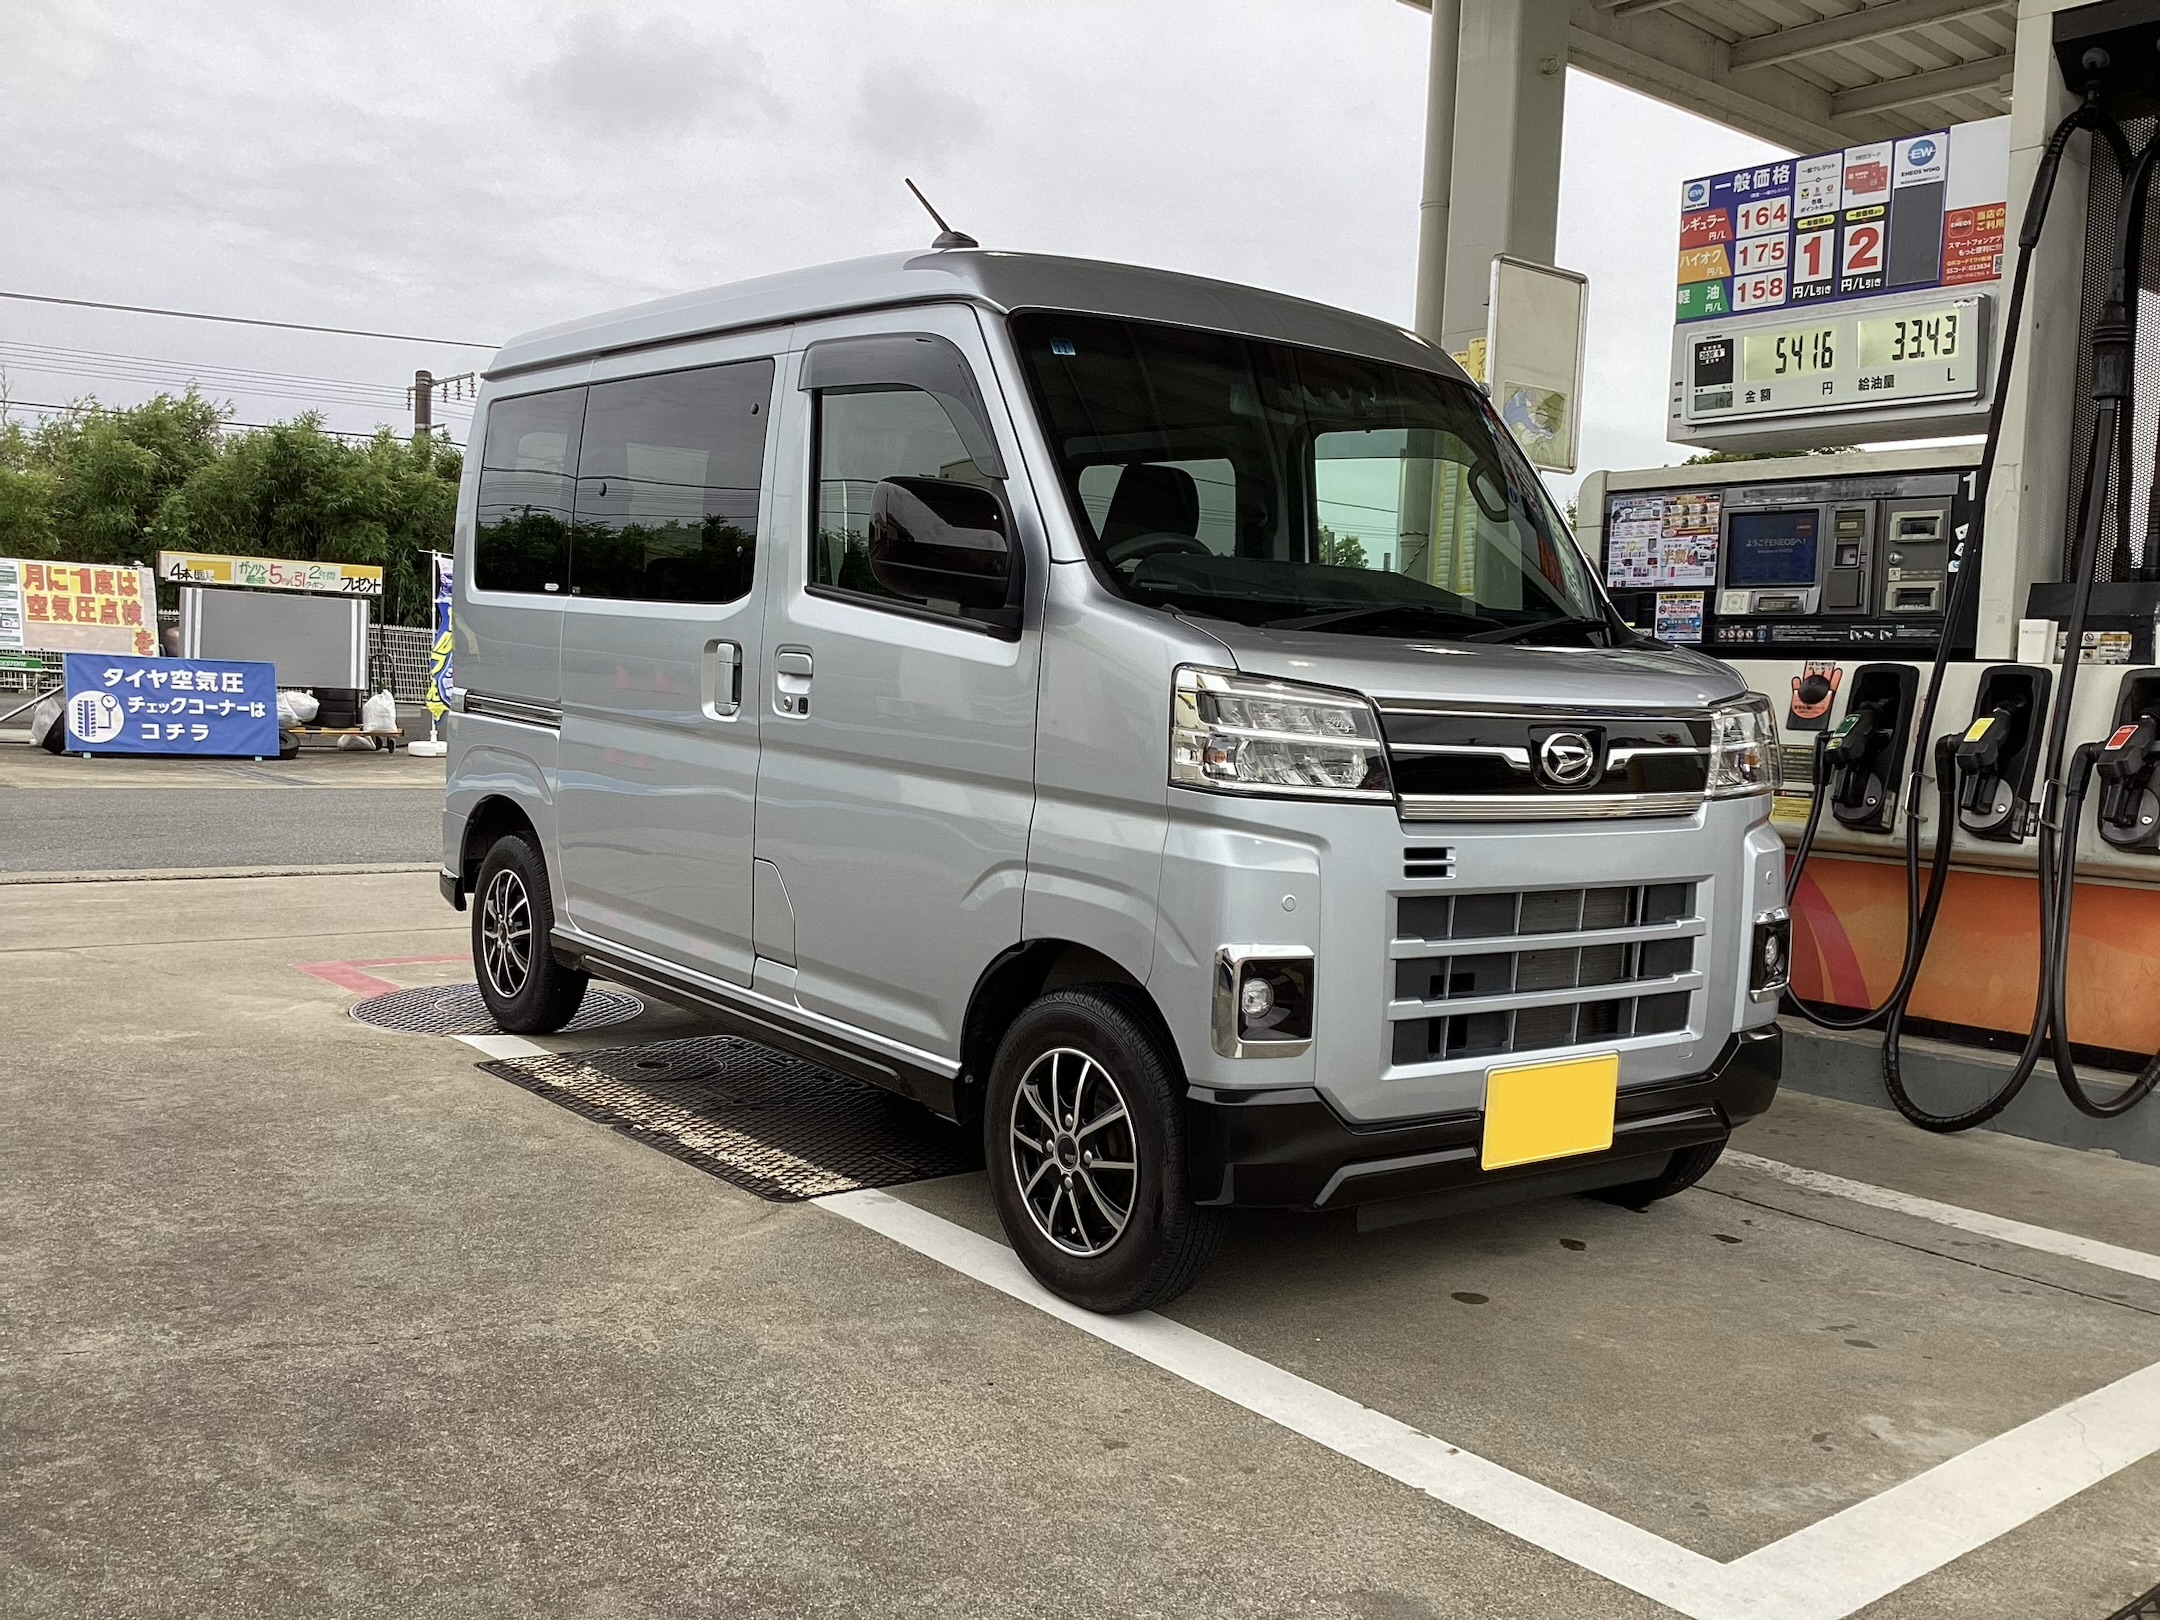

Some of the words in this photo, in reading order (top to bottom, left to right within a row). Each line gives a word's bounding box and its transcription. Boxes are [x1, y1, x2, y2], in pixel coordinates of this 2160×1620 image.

[1911, 147, 1933, 159] EW
[1715, 164, 1790, 193] 一般価格
[1901, 169, 1922, 177] ENEOS
[1741, 203, 1787, 230] 164
[1977, 207, 2005, 220] 当店の
[1681, 214, 1725, 233] レギュラー
[1951, 220, 1972, 228] ENEOS
[1976, 218, 2005, 231] ご利用
[1709, 231, 1726, 241] 円/L
[1740, 241, 1784, 266] 175
[1804, 236, 1821, 276] 1
[1847, 227, 1879, 270] 2
[1680, 250, 1722, 268] ハイオク
[1707, 267, 1724, 277] 円/L
[1737, 277, 1783, 303] 158
[1792, 285, 1832, 299] 円/L引き
[1841, 277, 1882, 292] 円/L引き
[1677, 285, 1720, 304] 軽油
[1705, 302, 1722, 312] 円/L
[1892, 315, 1957, 361] 33.43
[1775, 331, 1833, 374] 5416
[1858, 374, 1895, 391] 給油量
[1947, 367, 1956, 382] L
[1745, 388, 1771, 403] 金額
[1822, 381, 1834, 395] 円
[1963, 471, 1977, 501] 1
[239, 561, 268, 576] ガソリン
[309, 565, 336, 581] 2年間
[23, 564, 138, 596] 月に1度は
[340, 577, 382, 594] プレゼント
[26, 594, 143, 626] 空気圧点検
[134, 630, 154, 656] を
[103, 668, 245, 693] タイヤ空気圧
[127, 696, 266, 718] チェックコーナーは
[141, 723, 210, 742] コチラ
